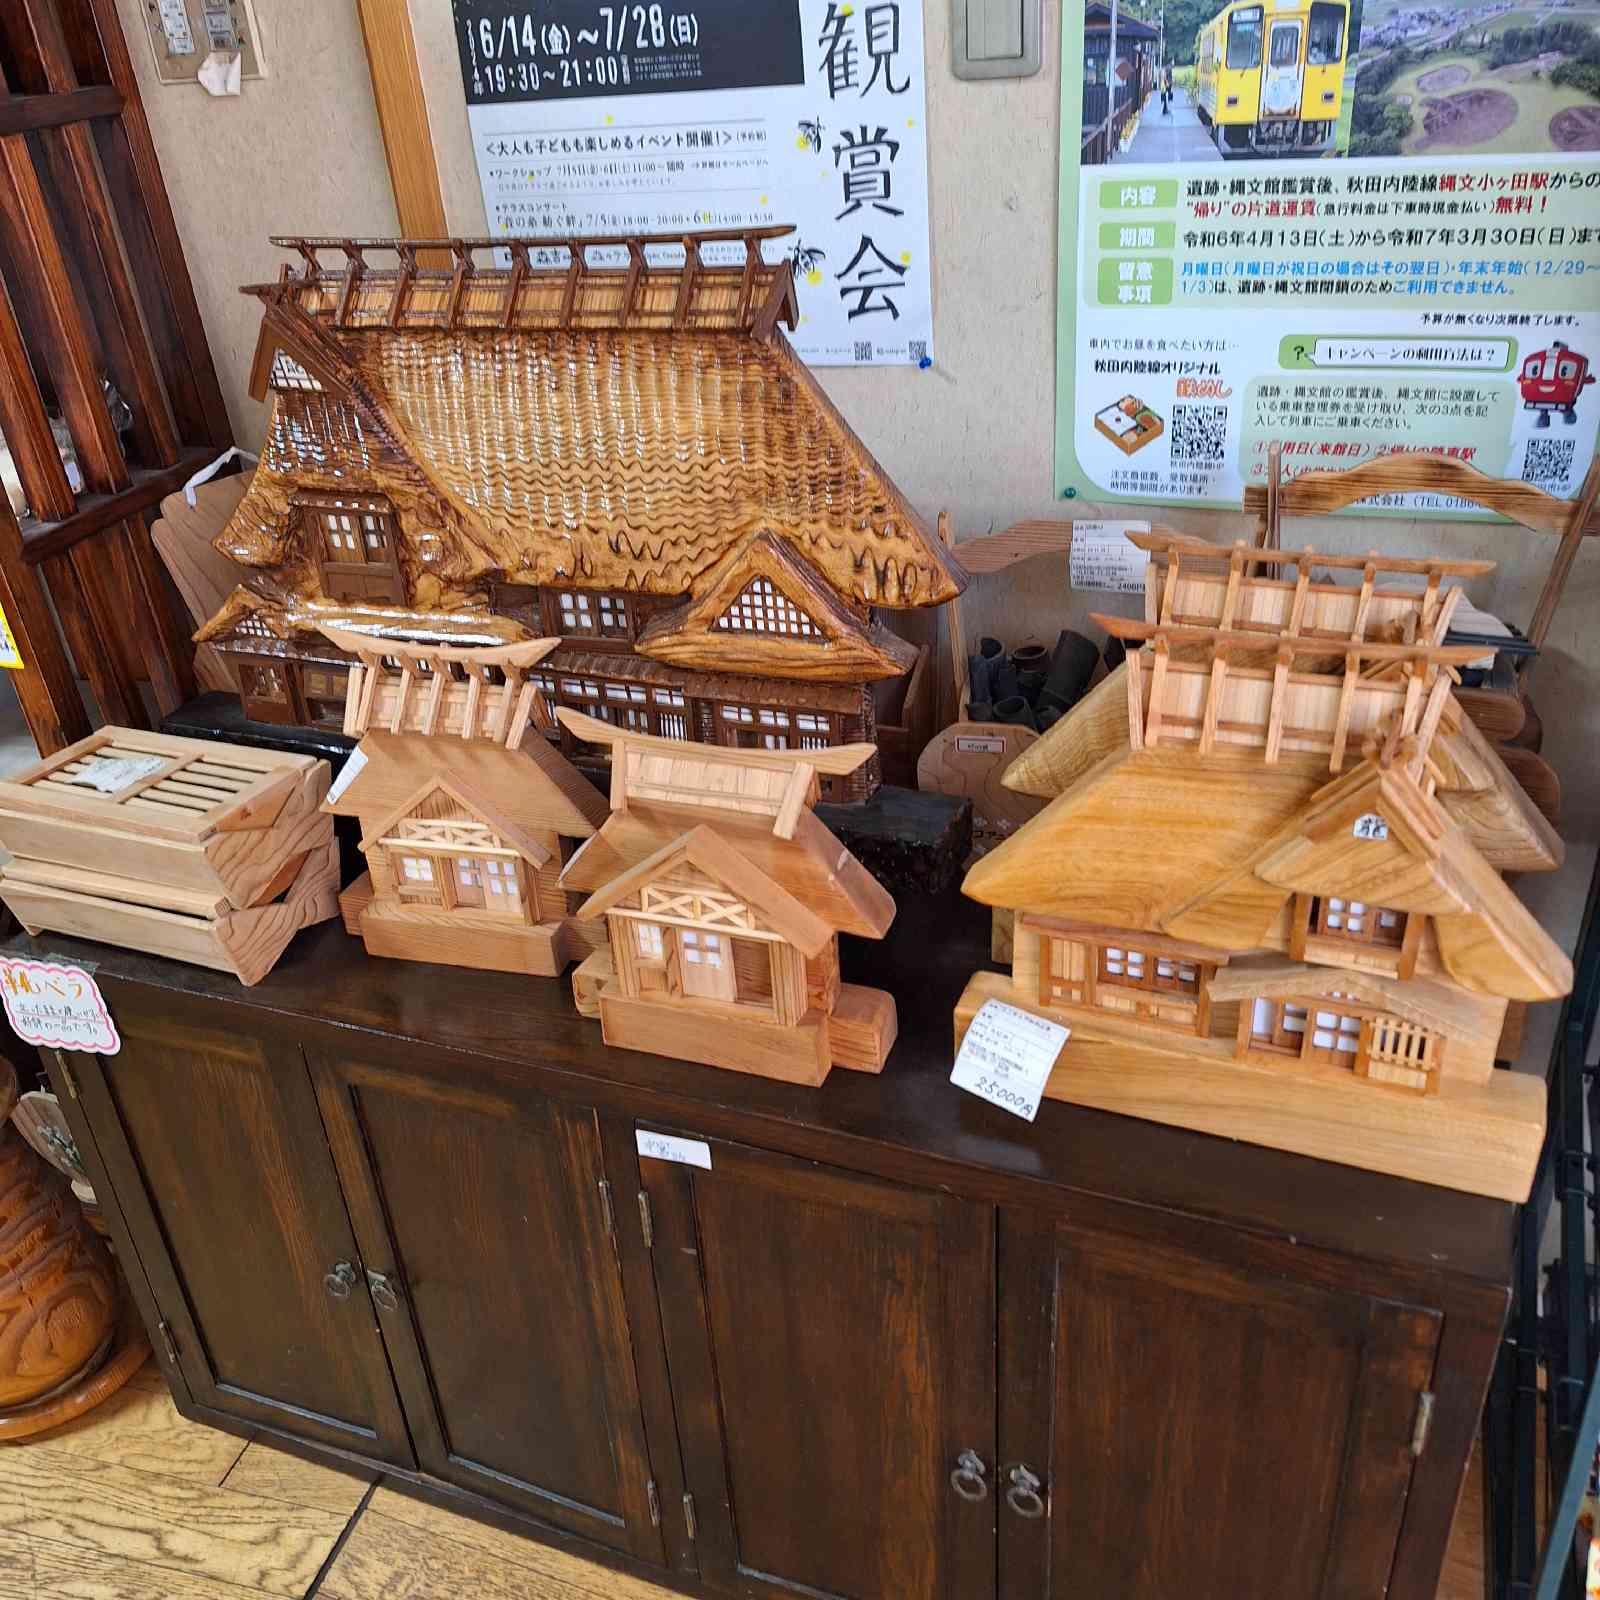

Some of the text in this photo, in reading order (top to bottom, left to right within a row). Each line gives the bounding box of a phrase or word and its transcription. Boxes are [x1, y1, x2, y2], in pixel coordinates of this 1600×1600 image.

[818, 2, 911, 322] 観賞会
[1118, 185, 1157, 208] 内容
[1119, 226, 1155, 249] 期間
